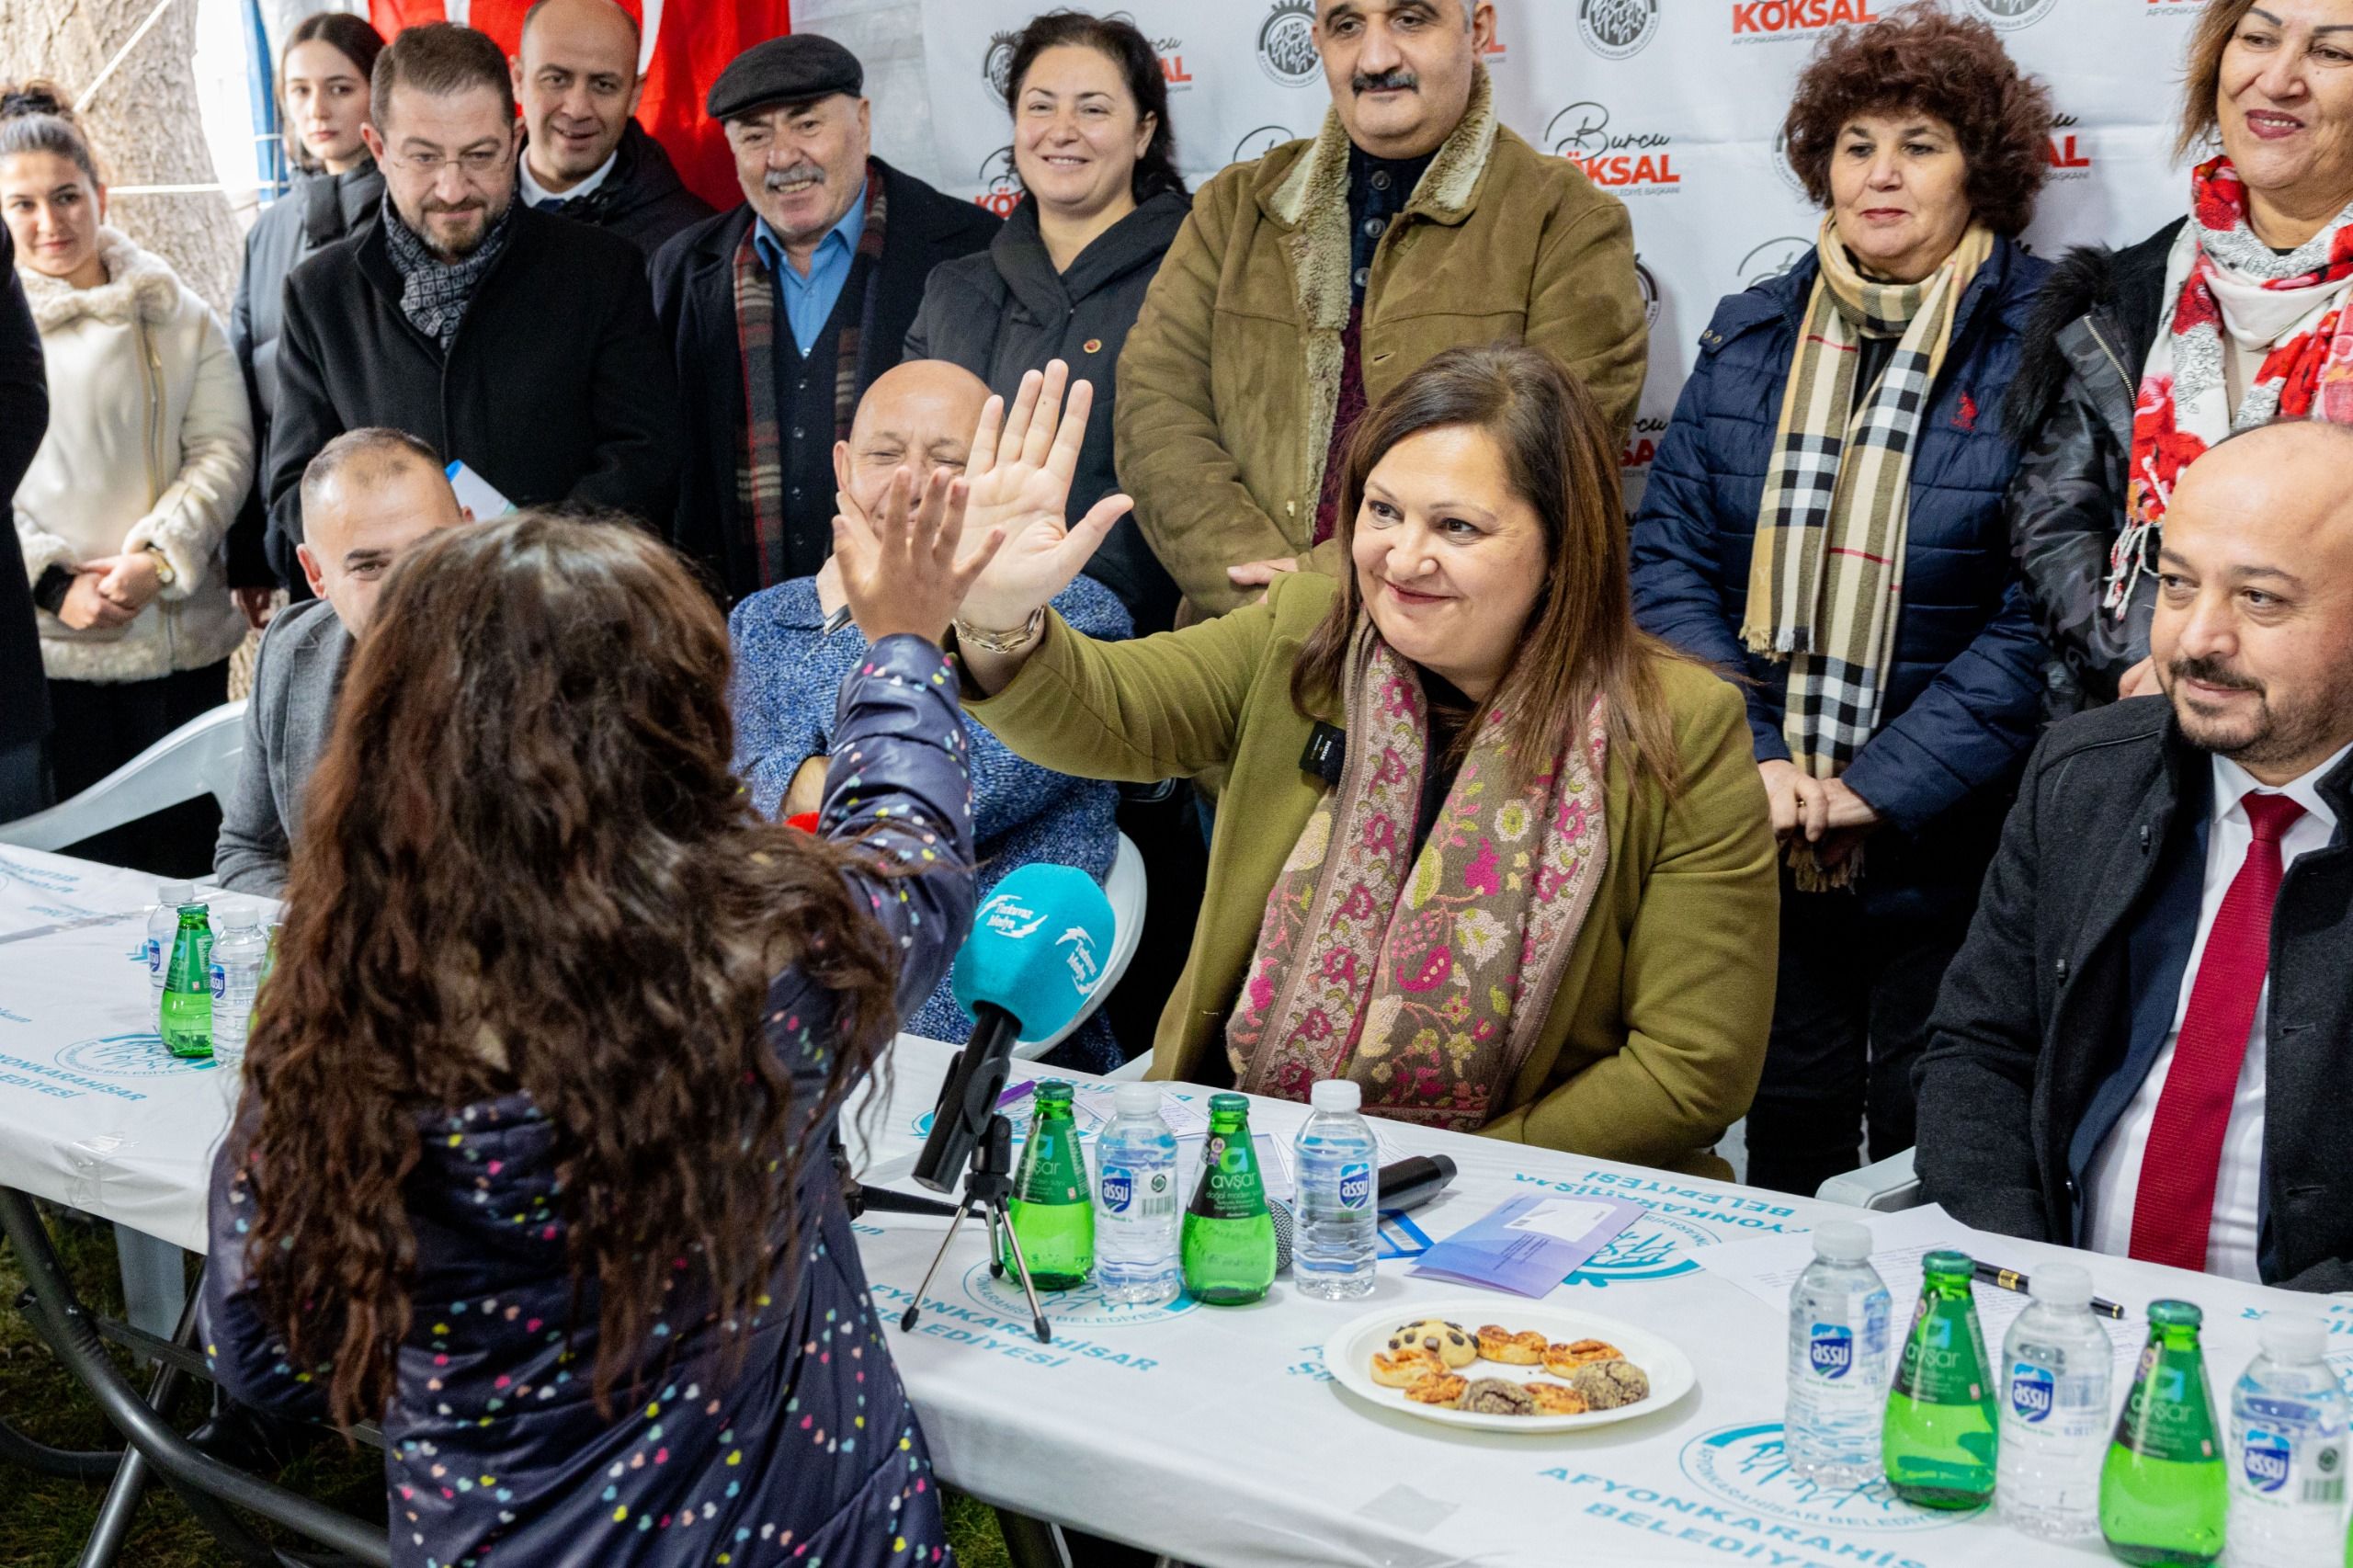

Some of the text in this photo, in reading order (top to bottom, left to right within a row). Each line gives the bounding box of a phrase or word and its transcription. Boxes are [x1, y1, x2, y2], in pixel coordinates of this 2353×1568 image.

[1544, 101, 1671, 163] Burcu
[1566, 151, 1681, 187] KSAL
[1211, 1172, 1256, 1190] avşar
[871, 1284, 1159, 1371] FYONKARAHİSAR
